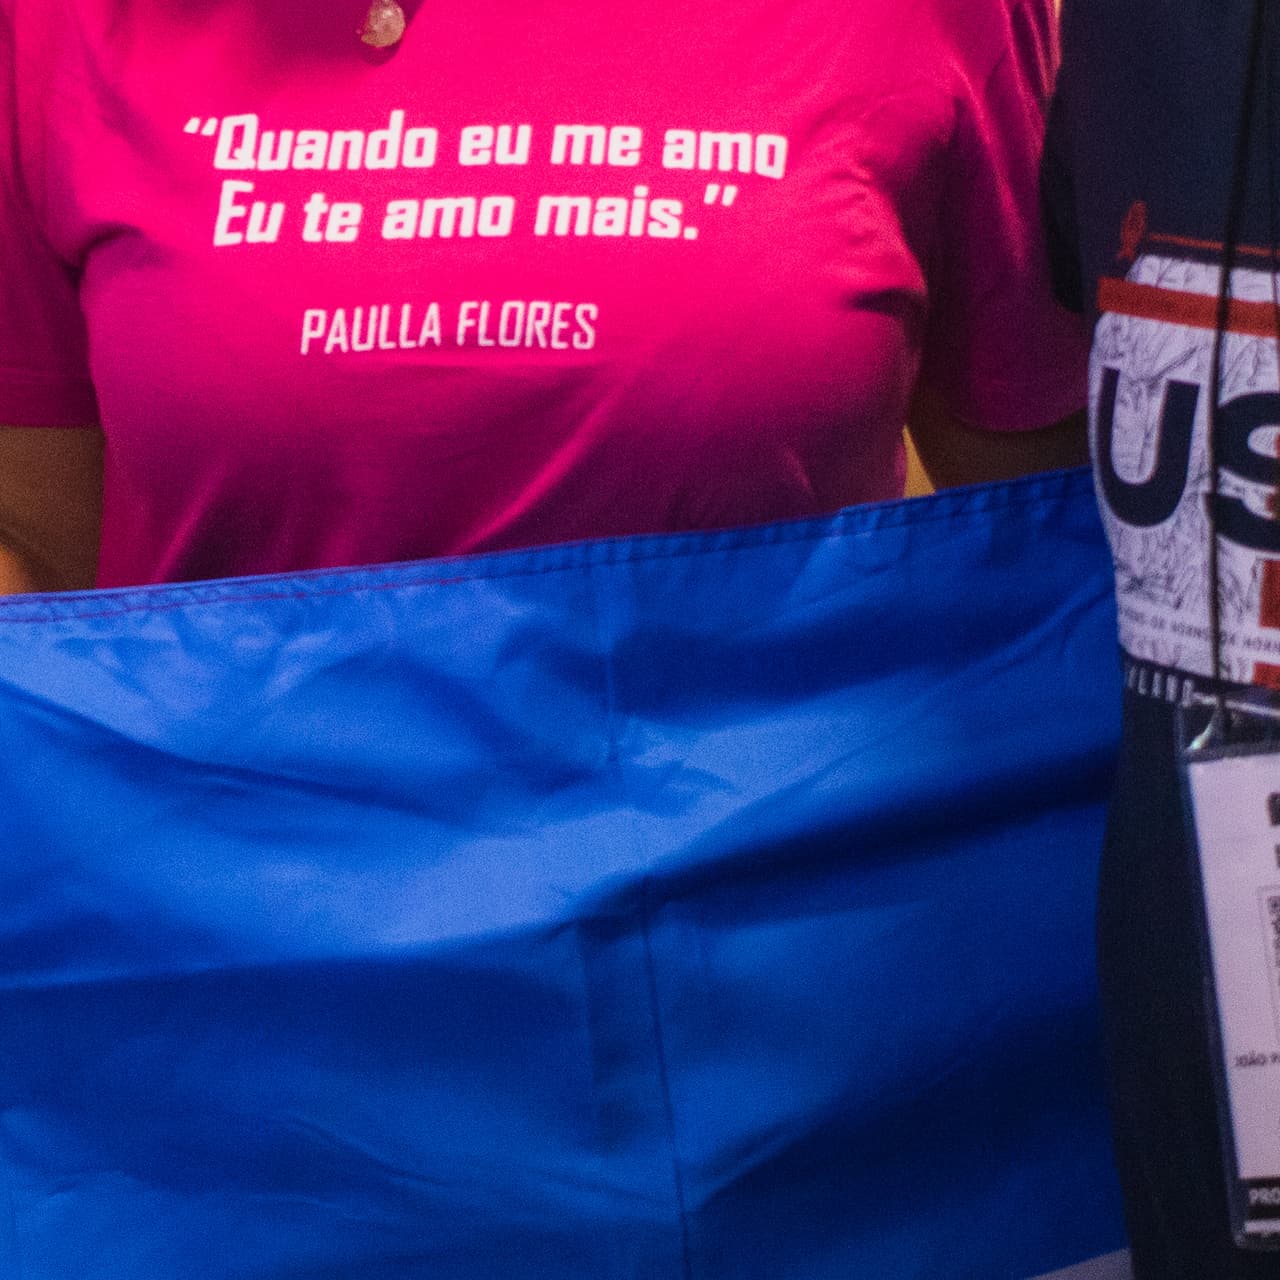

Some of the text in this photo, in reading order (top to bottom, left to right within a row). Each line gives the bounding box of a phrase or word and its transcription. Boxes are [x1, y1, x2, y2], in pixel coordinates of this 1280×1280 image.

[183, 109, 789, 180] “Quando eu me amo
[213, 179, 285, 248] Eu
[301, 192, 364, 243] te
[380, 195, 515, 240] amo
[300, 300, 598, 356] PAULLA FLORES
